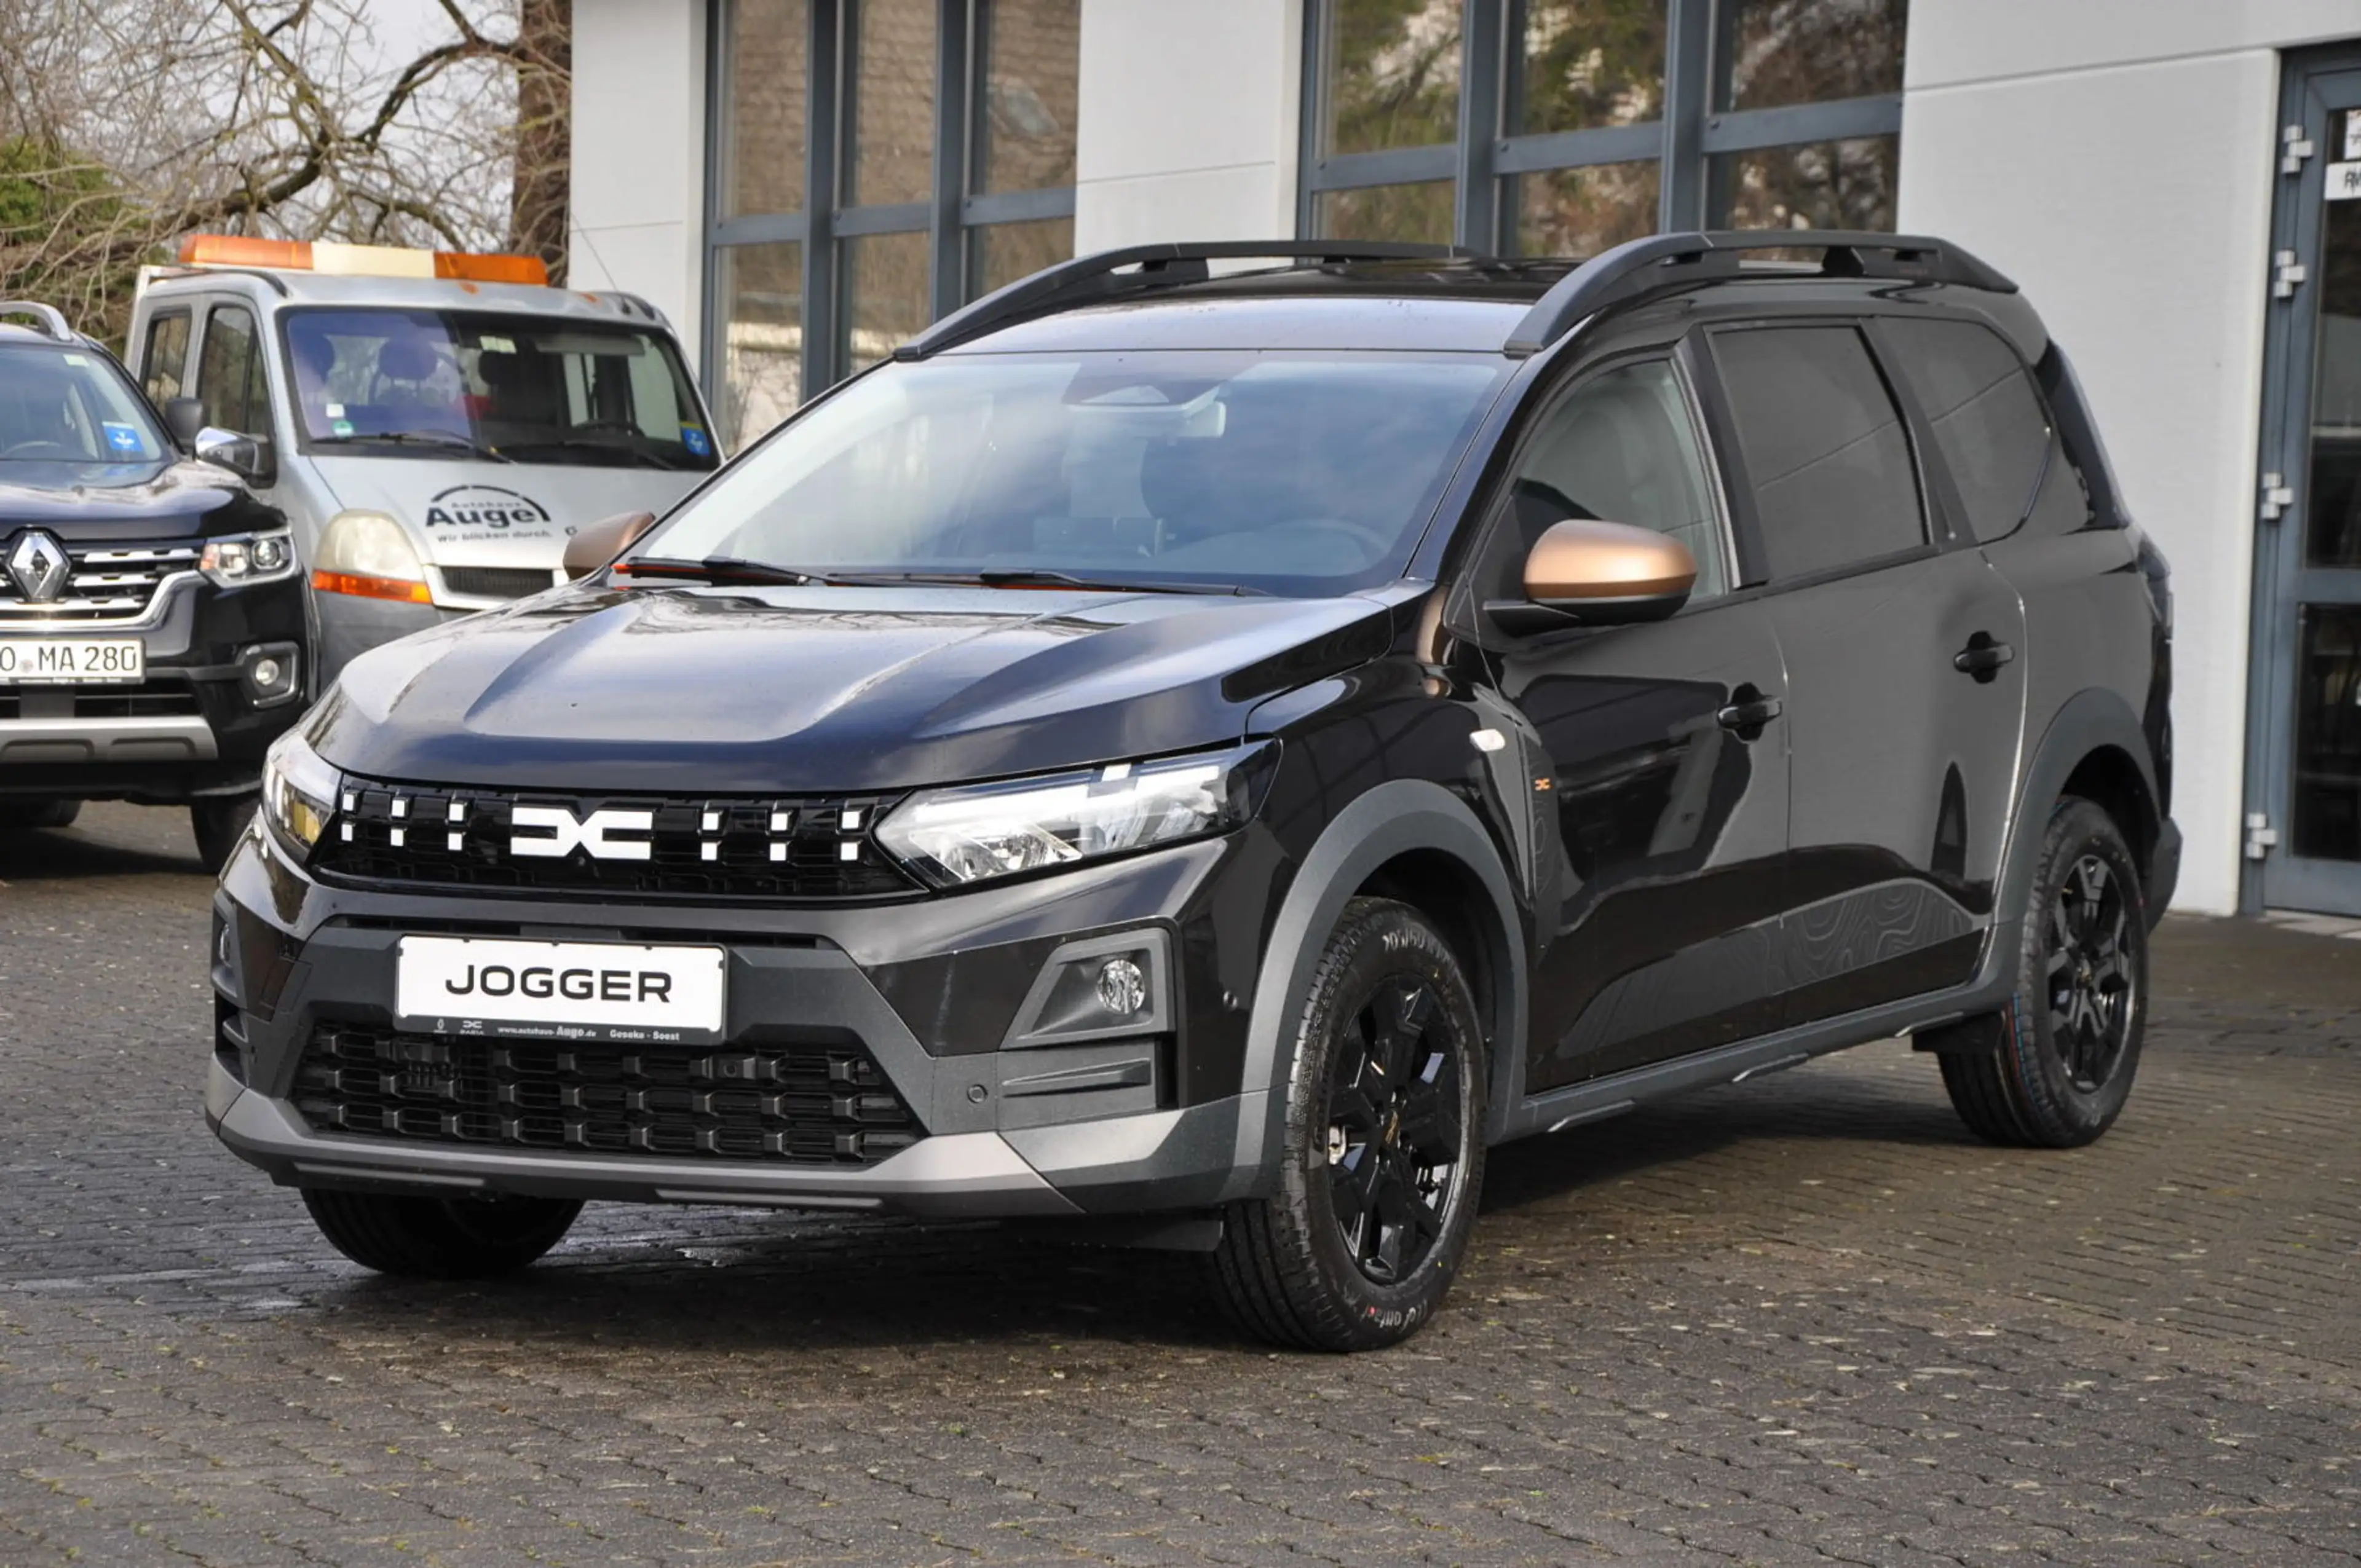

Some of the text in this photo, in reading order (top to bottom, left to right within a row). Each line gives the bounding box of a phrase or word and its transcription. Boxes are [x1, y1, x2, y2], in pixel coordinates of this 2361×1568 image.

[425, 506, 537, 529] Auge
[39, 647, 75, 671] MA
[84, 647, 136, 671] 280
[446, 964, 671, 1003] JOGGER
[652, 1031, 679, 1041] Soest
